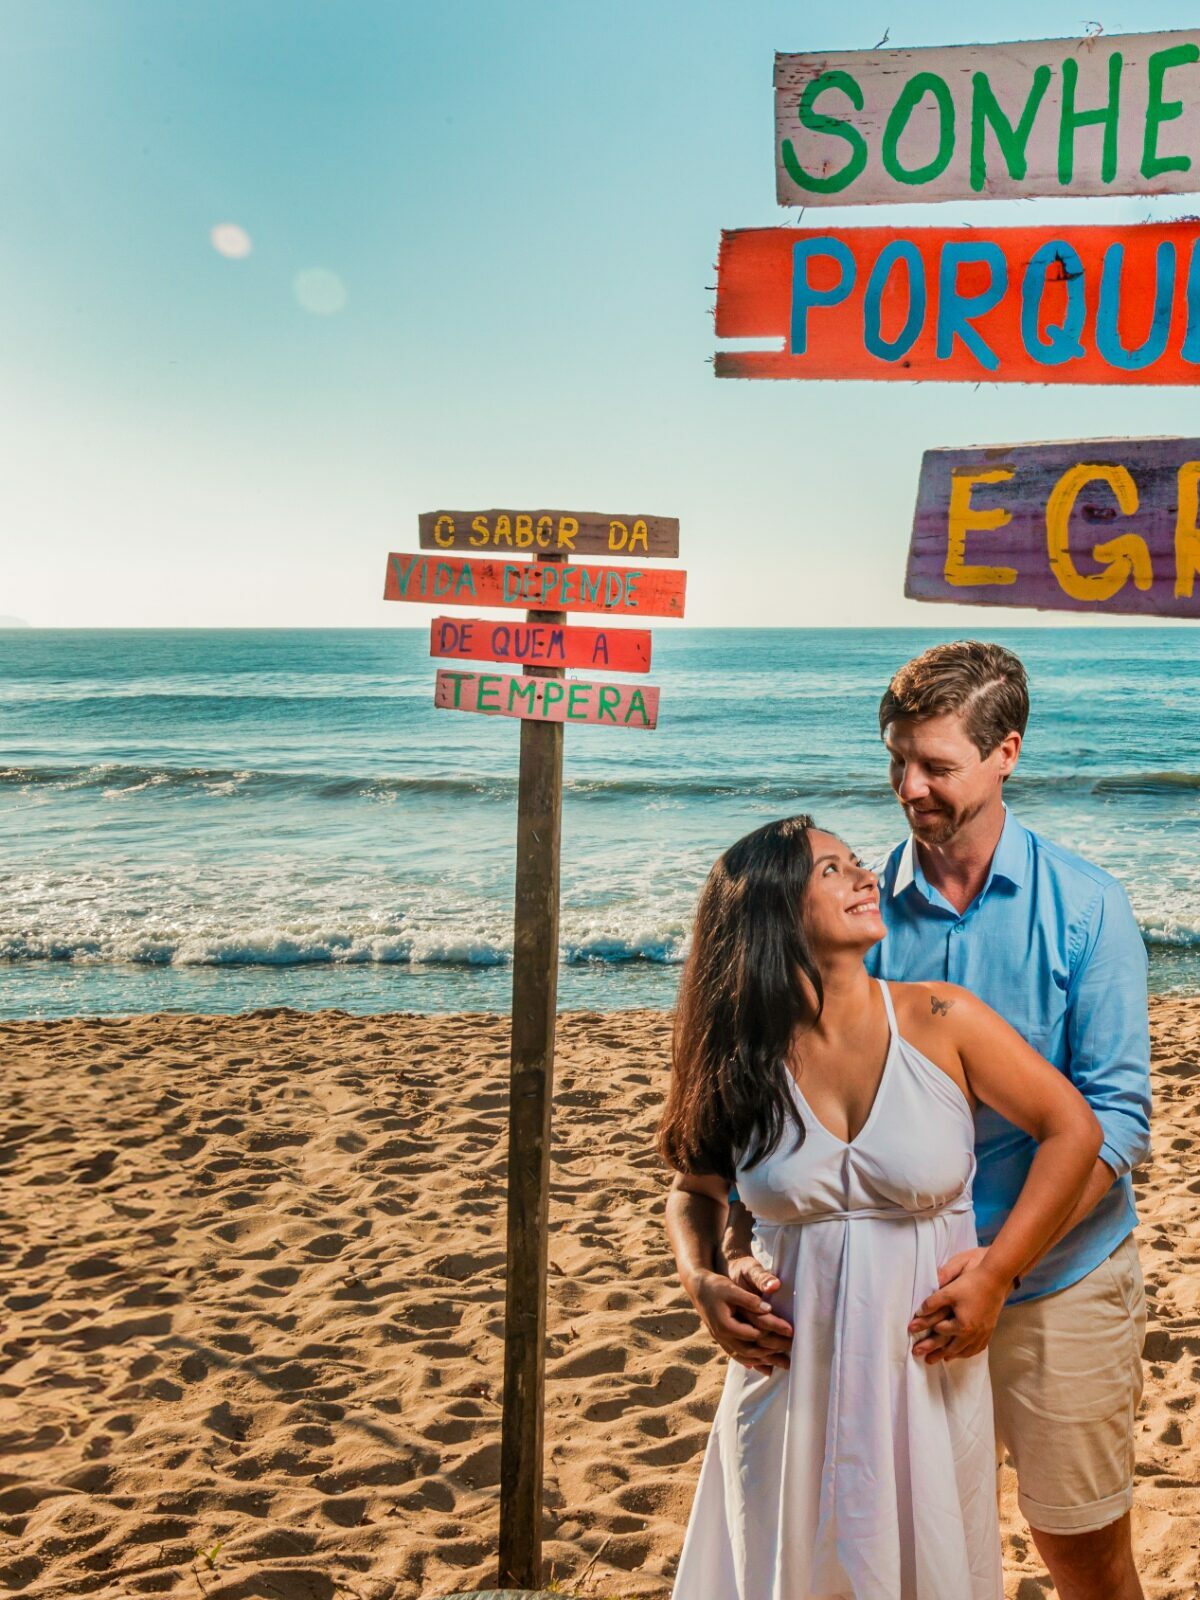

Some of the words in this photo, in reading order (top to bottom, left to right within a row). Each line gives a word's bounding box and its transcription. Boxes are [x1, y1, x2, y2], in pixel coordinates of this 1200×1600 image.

[782, 43, 1200, 194] SONHE
[434, 516, 455, 547] O
[469, 515, 579, 550] SABOR
[608, 520, 648, 552] DA
[944, 462, 1018, 587] E
[392, 555, 476, 597] VIDA
[503, 564, 642, 607] DEPENDE
[440, 623, 473, 652] DE
[491, 626, 565, 659] QUEM
[592, 633, 609, 665] A
[441, 673, 649, 725] TEMPERA
